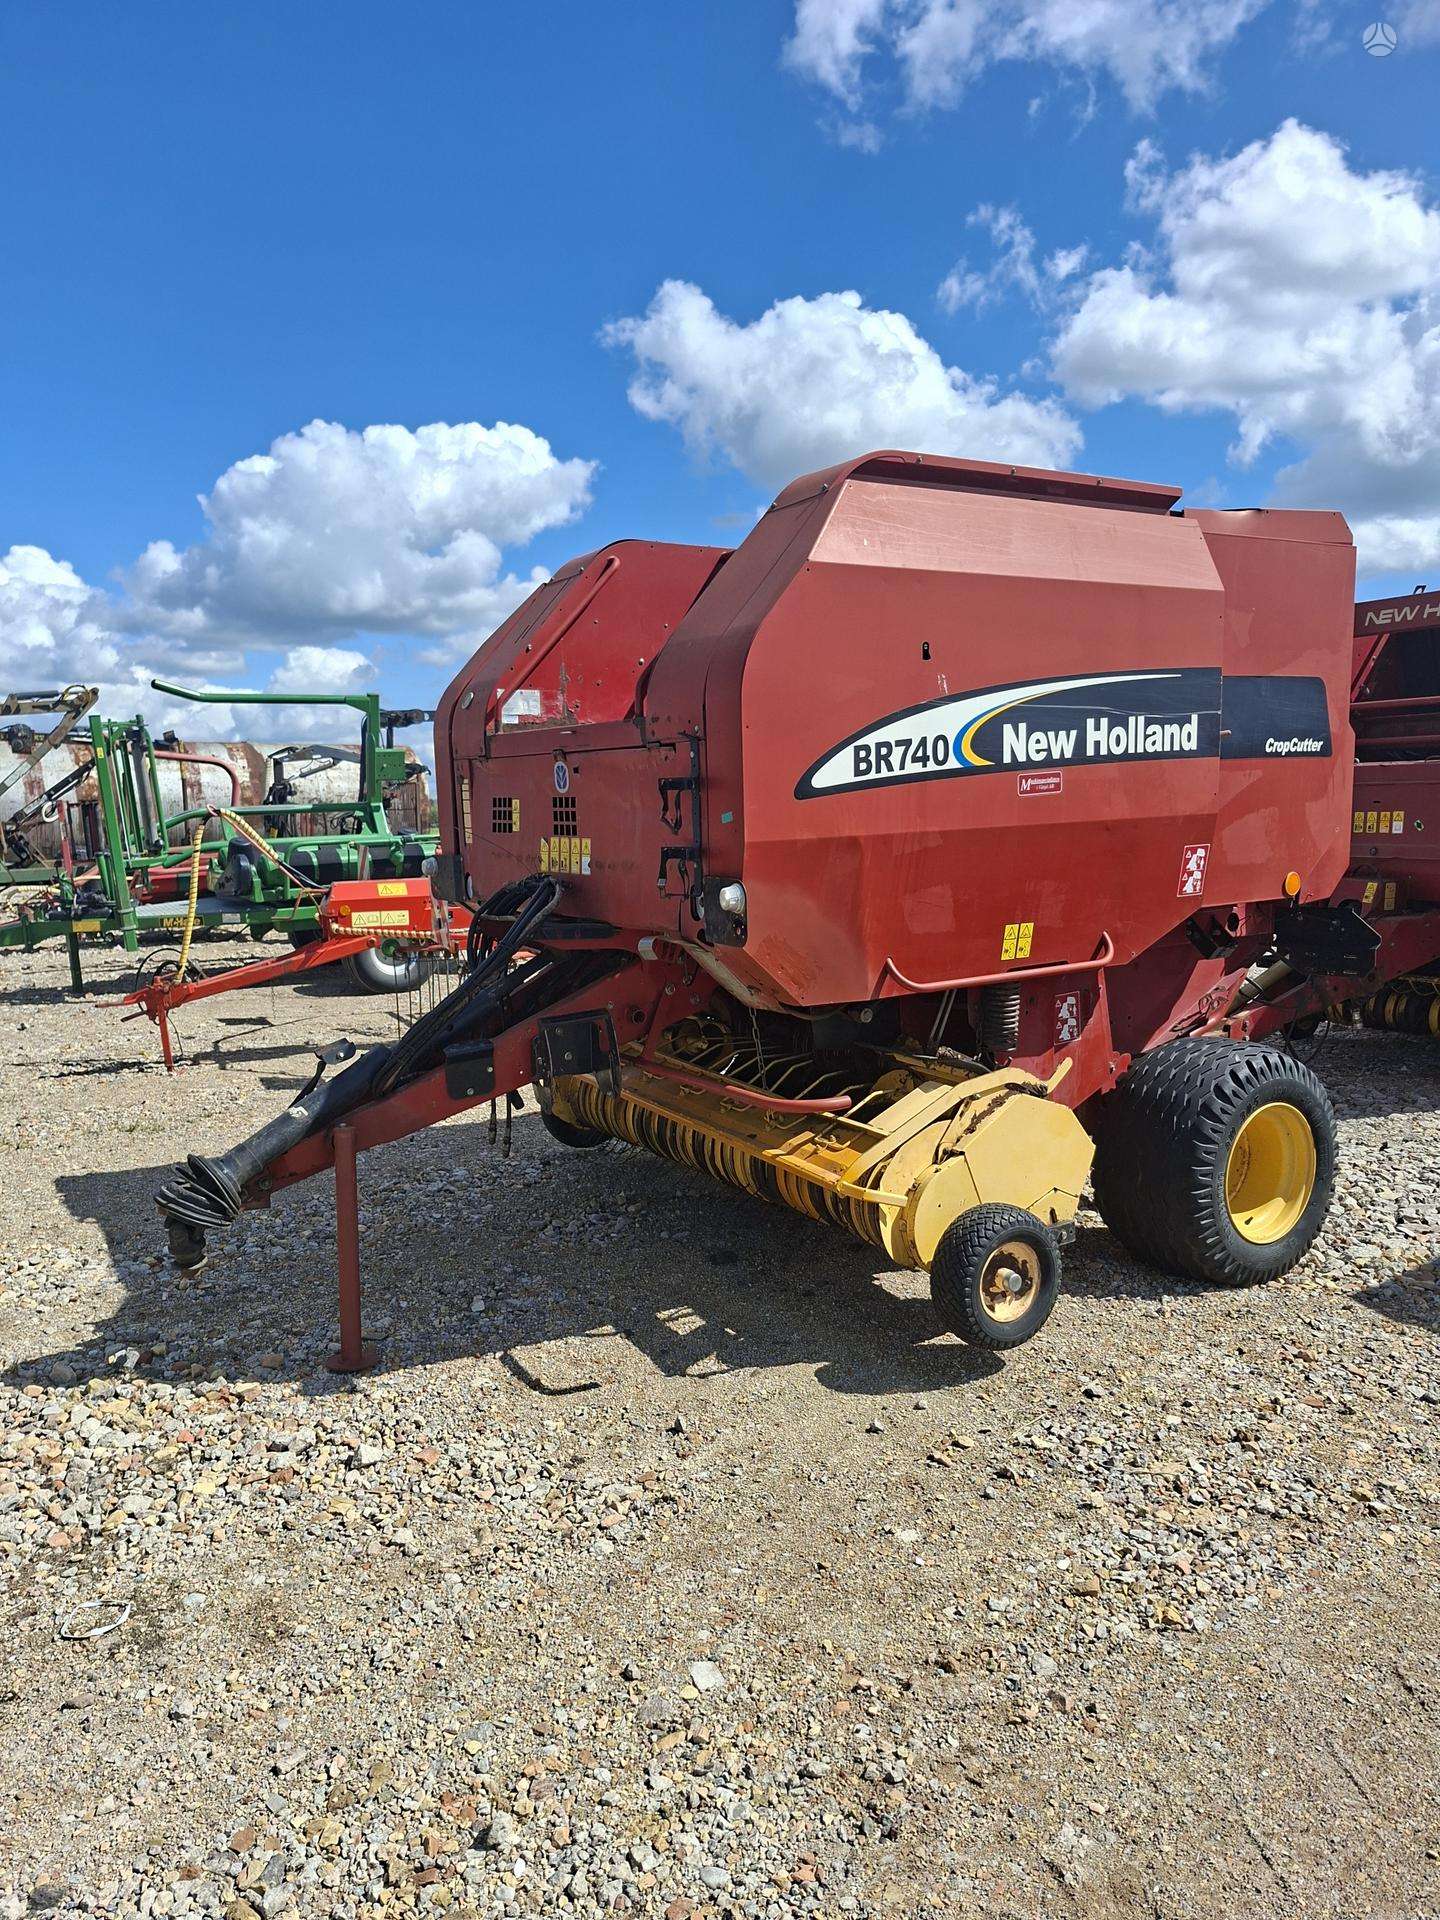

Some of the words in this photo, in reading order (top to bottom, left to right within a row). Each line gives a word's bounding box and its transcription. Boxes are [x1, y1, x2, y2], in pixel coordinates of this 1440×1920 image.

[1365, 605, 1420, 626] NEW
[1002, 722, 1078, 764] New
[1086, 713, 1199, 757] Holland
[1265, 737, 1324, 756] CropCutter
[853, 734, 950, 778] BR740
[163, 917, 201, 928] McHae
